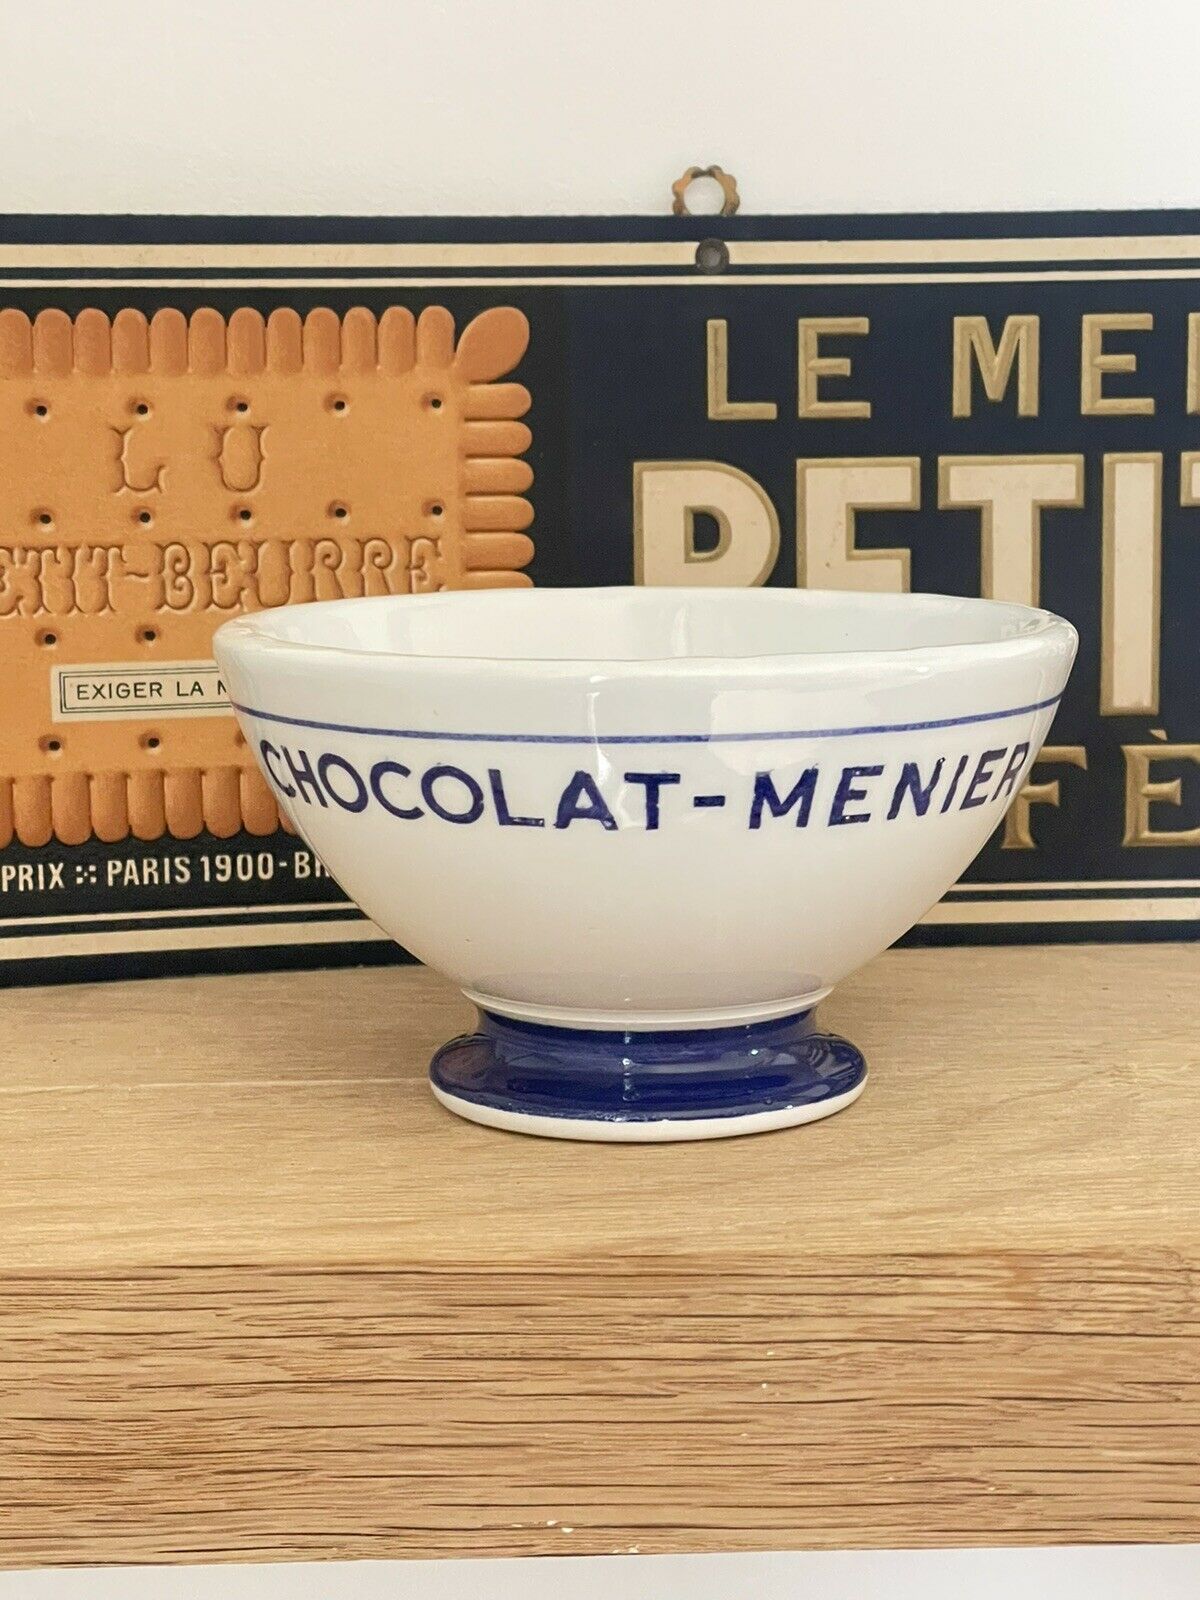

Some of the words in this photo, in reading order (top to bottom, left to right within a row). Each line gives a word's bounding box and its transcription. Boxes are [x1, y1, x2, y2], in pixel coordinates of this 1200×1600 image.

[707, 317, 871, 420] LE
[110, 423, 269, 496] LU
[633, 451, 1200, 717] PETI
[77, 682, 163, 700] EXIGER
[177, 680, 204, 697] LA
[2, 861, 65, 892] PRIX
[107, 856, 191, 887] PARIS
